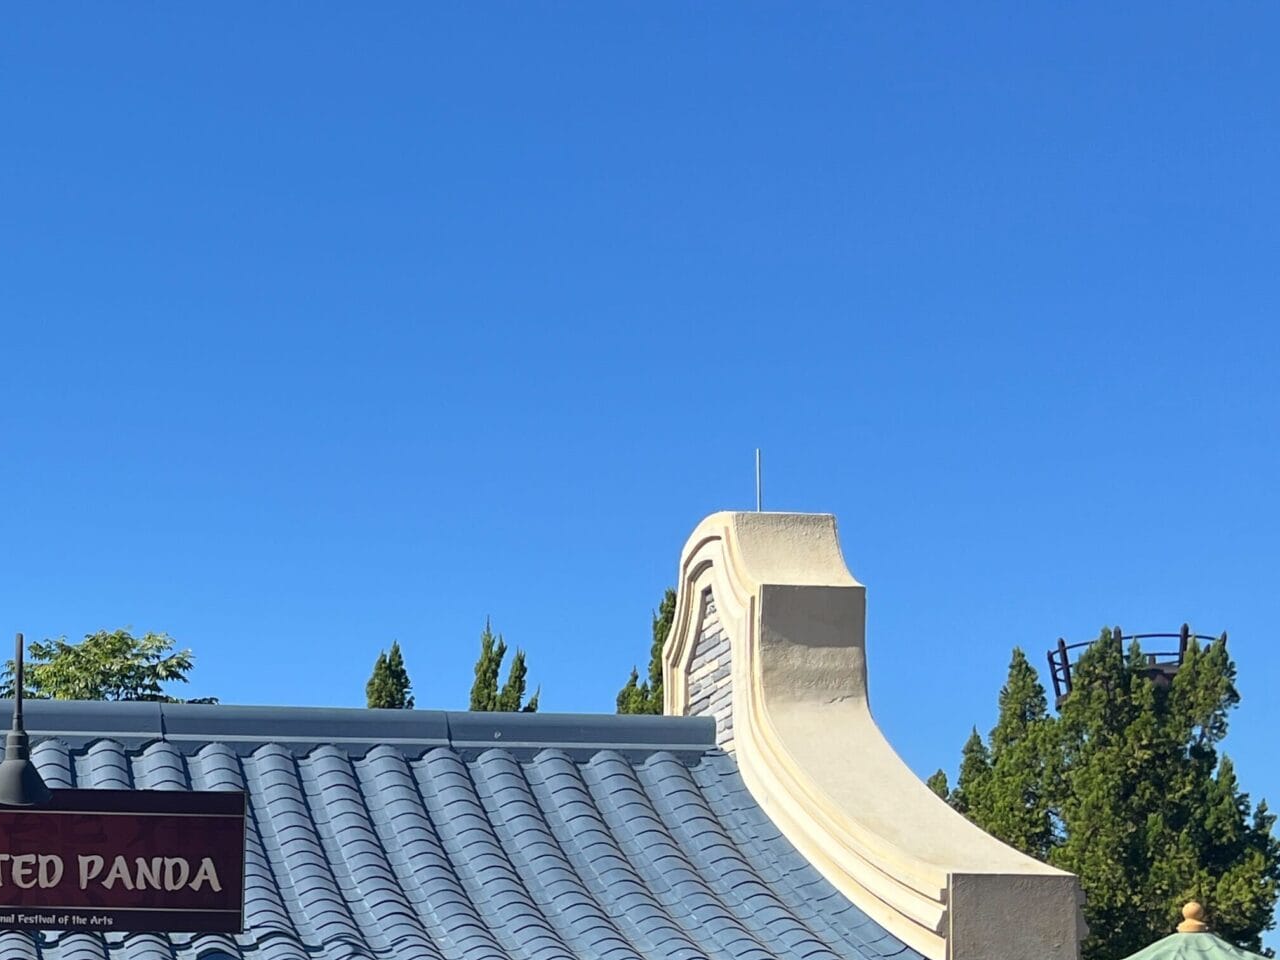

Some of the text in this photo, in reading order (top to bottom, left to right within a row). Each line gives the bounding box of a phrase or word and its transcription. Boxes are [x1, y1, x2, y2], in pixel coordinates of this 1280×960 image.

[78, 854, 222, 892] PANDA
[18, 914, 56, 924] Festival
[58, 915, 70, 925] of
[72, 915, 87, 925] the
[90, 915, 113, 925] Arts
